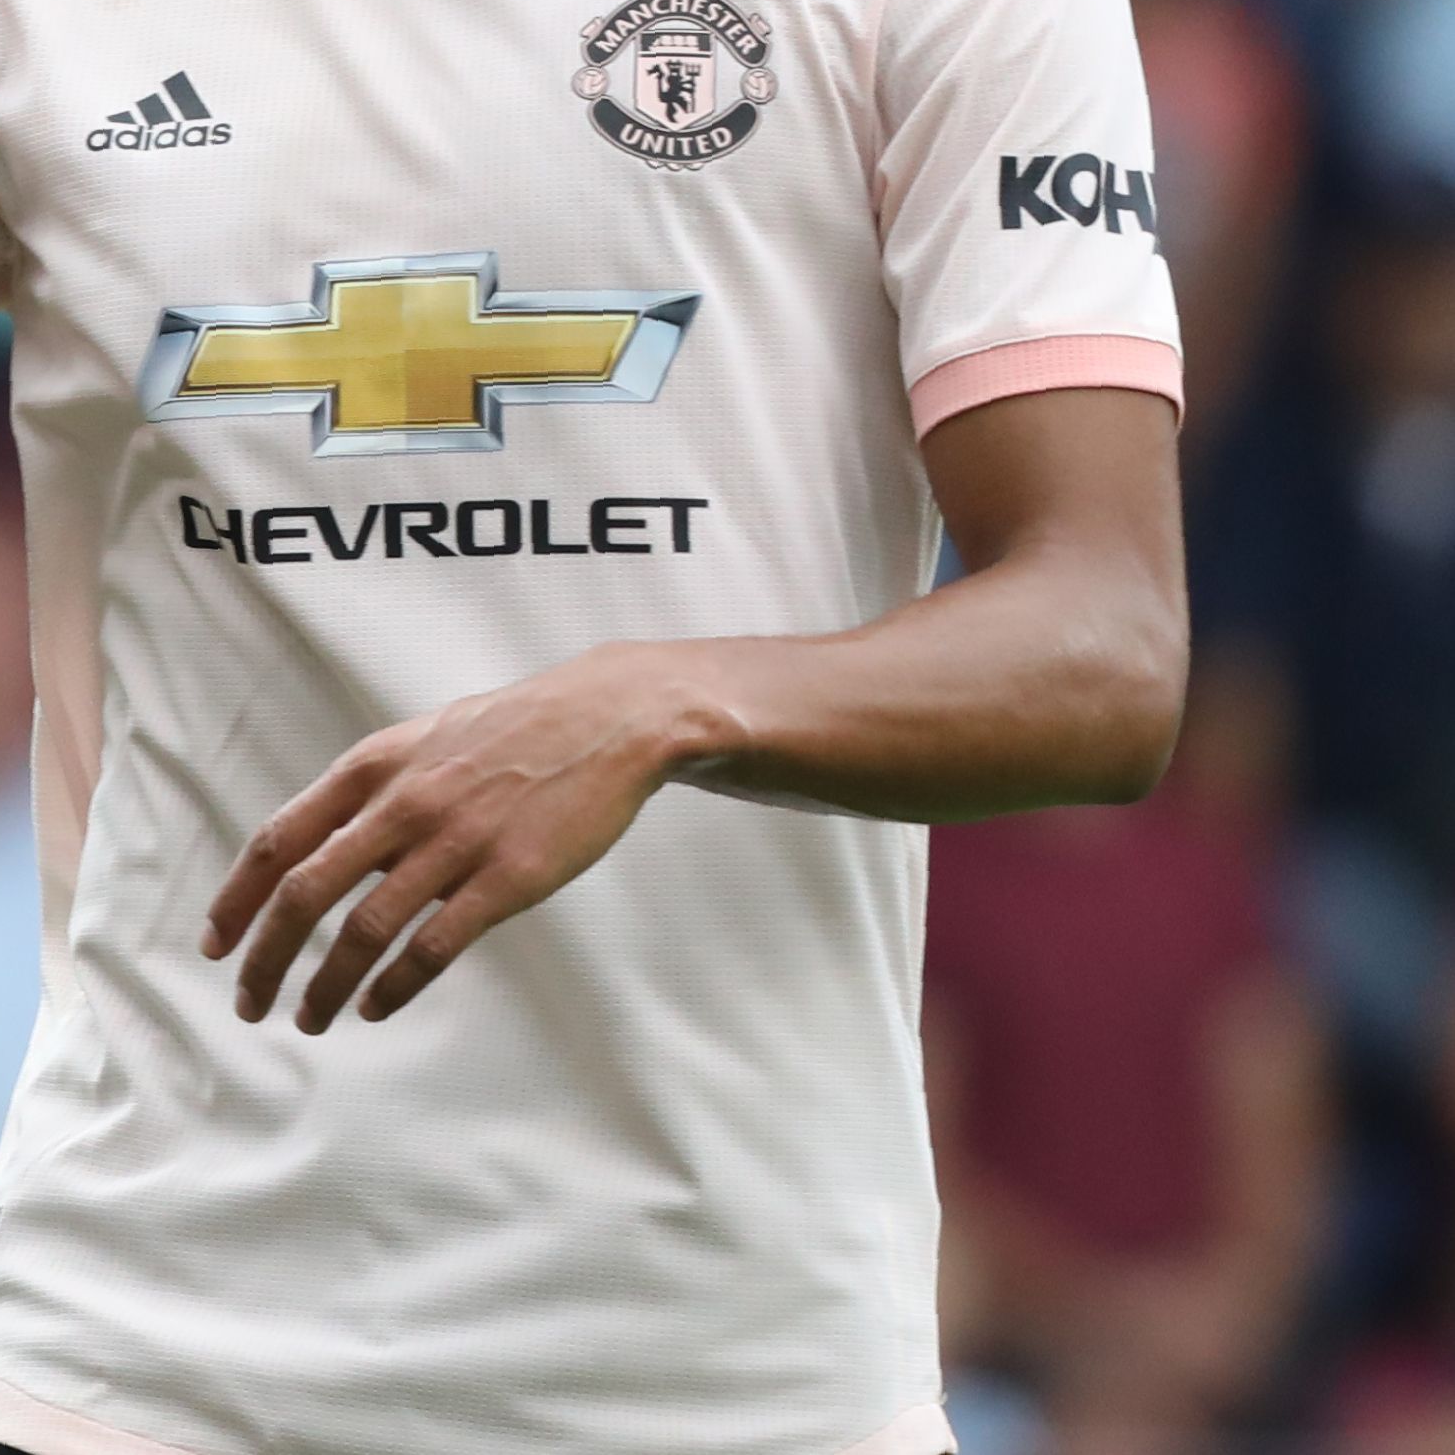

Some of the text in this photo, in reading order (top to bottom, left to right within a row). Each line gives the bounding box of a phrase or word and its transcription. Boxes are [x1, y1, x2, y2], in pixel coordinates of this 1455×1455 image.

[86, 121, 232, 152] adidas
[619, 123, 733, 156] UNITED
[999, 152, 1156, 235] KOH
[179, 495, 709, 565] CHEVROLET
